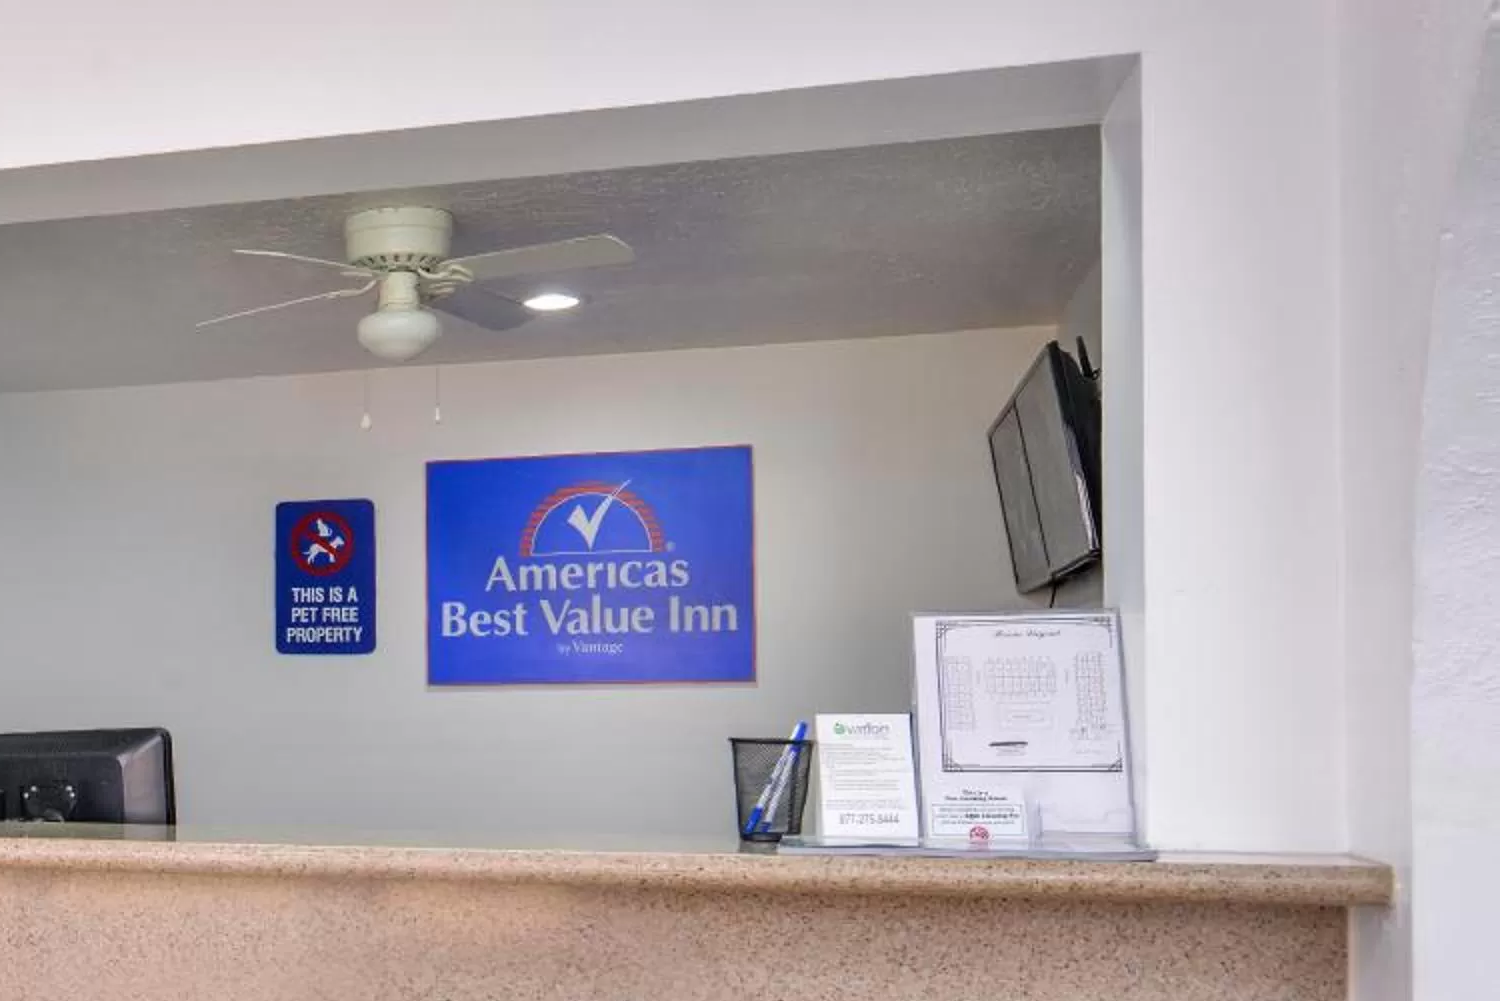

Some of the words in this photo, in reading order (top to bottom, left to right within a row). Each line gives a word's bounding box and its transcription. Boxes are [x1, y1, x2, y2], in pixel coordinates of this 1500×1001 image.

[485, 555, 689, 592] Americas
[291, 586, 325, 603] THIS
[329, 586, 343, 603] IS
[347, 586, 359, 603] A
[291, 607, 319, 623] PET
[322, 607, 359, 623] FREE
[441, 601, 529, 637] Best
[540, 594, 654, 636] Value
[669, 595, 738, 632] Inn
[286, 626, 363, 643] PROPERTY
[572, 639, 624, 656] Vantage
